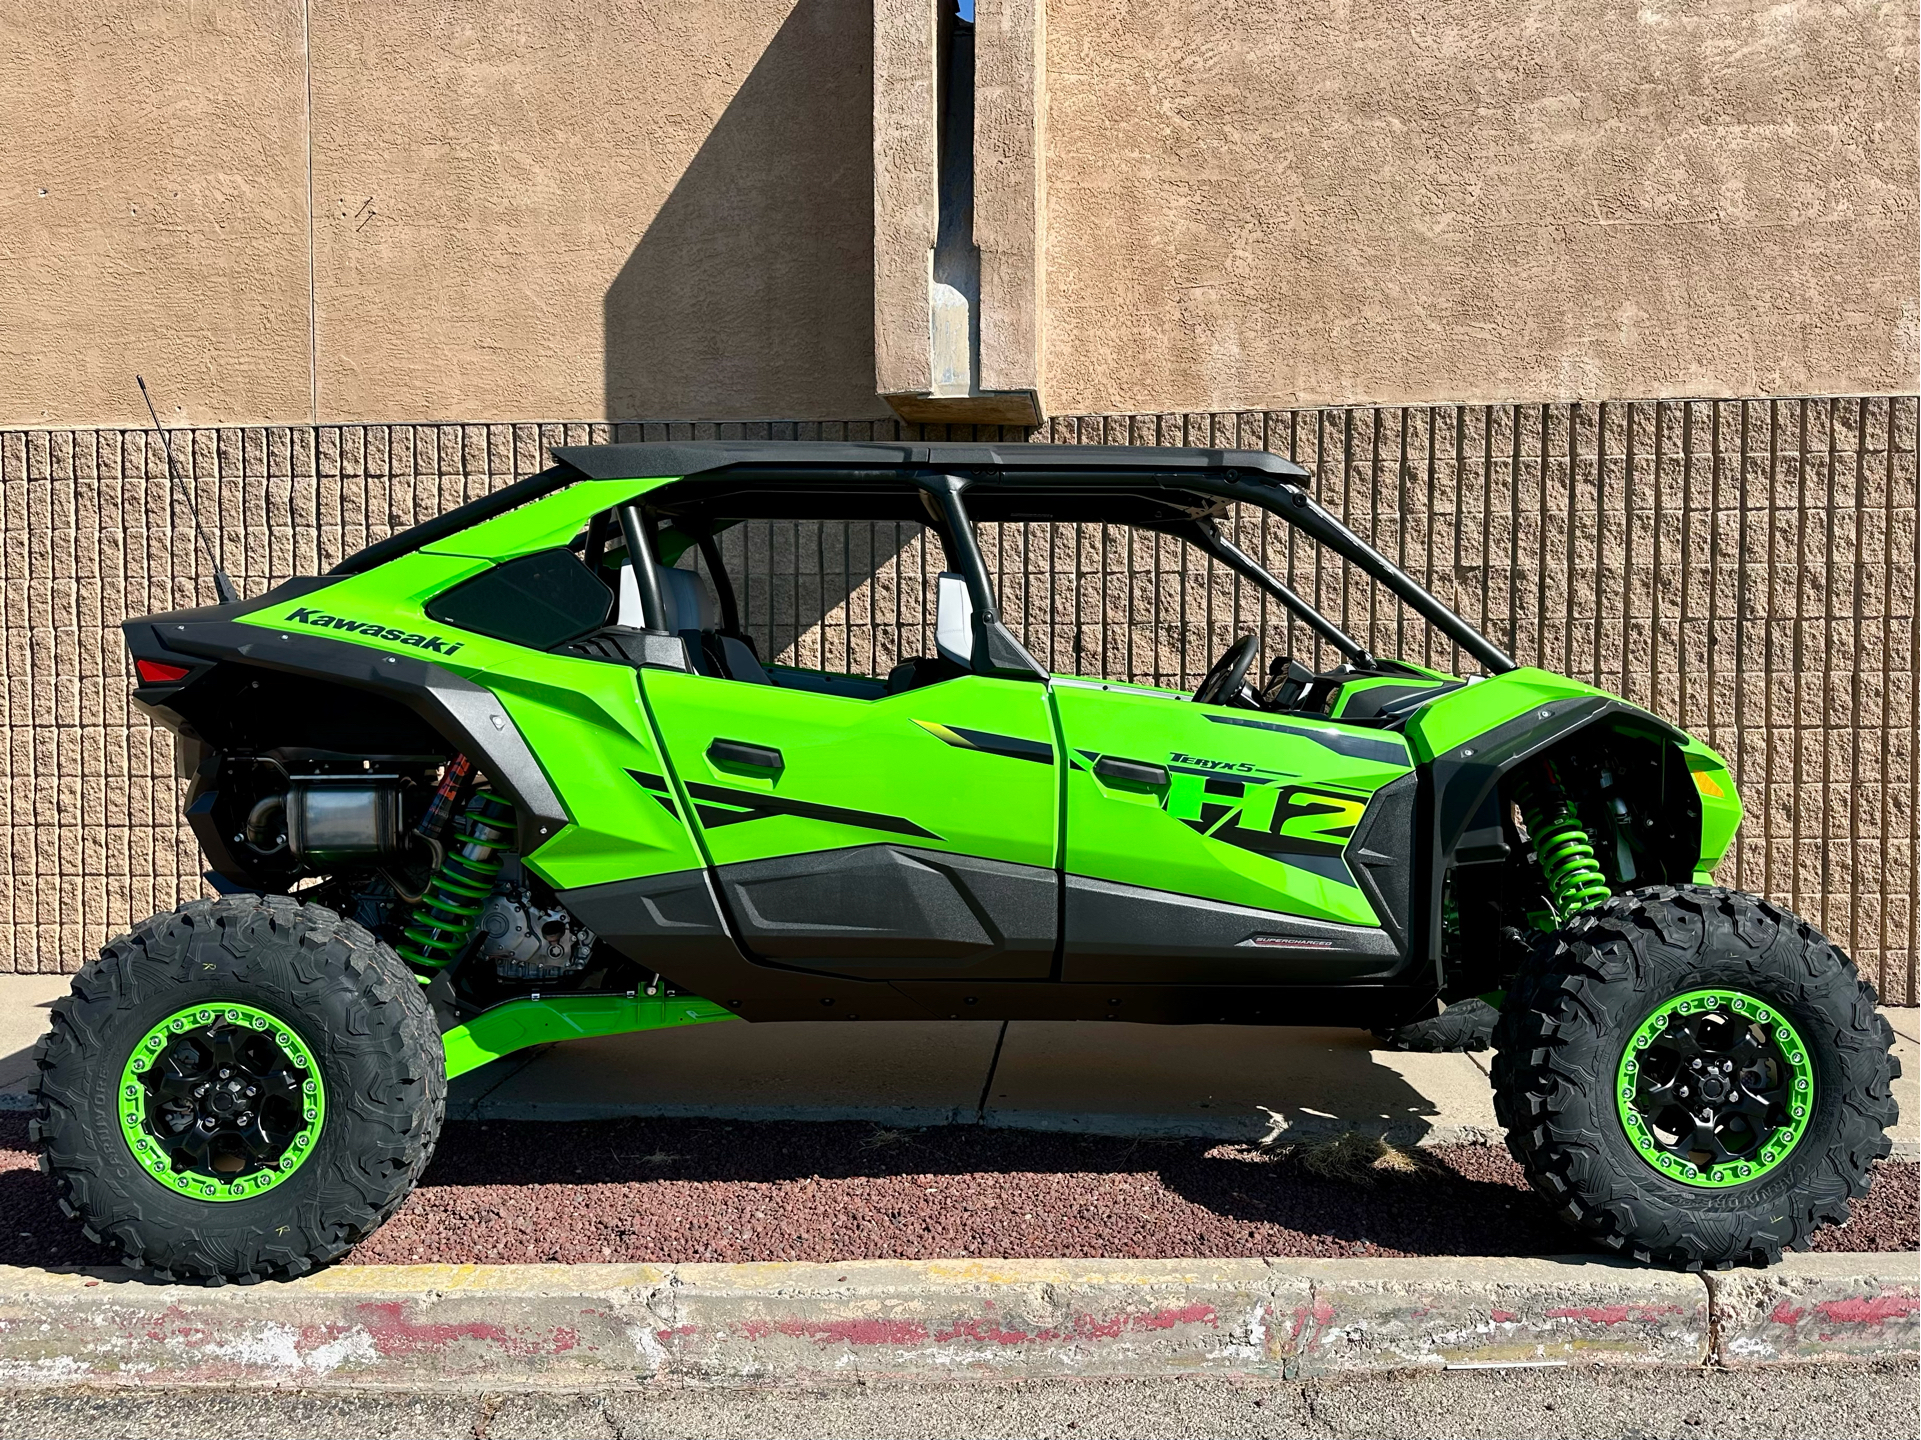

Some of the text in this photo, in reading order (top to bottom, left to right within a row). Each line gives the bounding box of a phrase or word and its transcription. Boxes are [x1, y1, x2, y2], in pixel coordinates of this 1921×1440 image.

[284, 607, 465, 656] Kawasaki
[1168, 773, 1367, 846] H2
[1256, 937, 1333, 946] SUPERCHARGED
[94, 1067, 129, 1179] CARNIVORE
[1707, 1162, 1806, 1210] CARNIVORE
